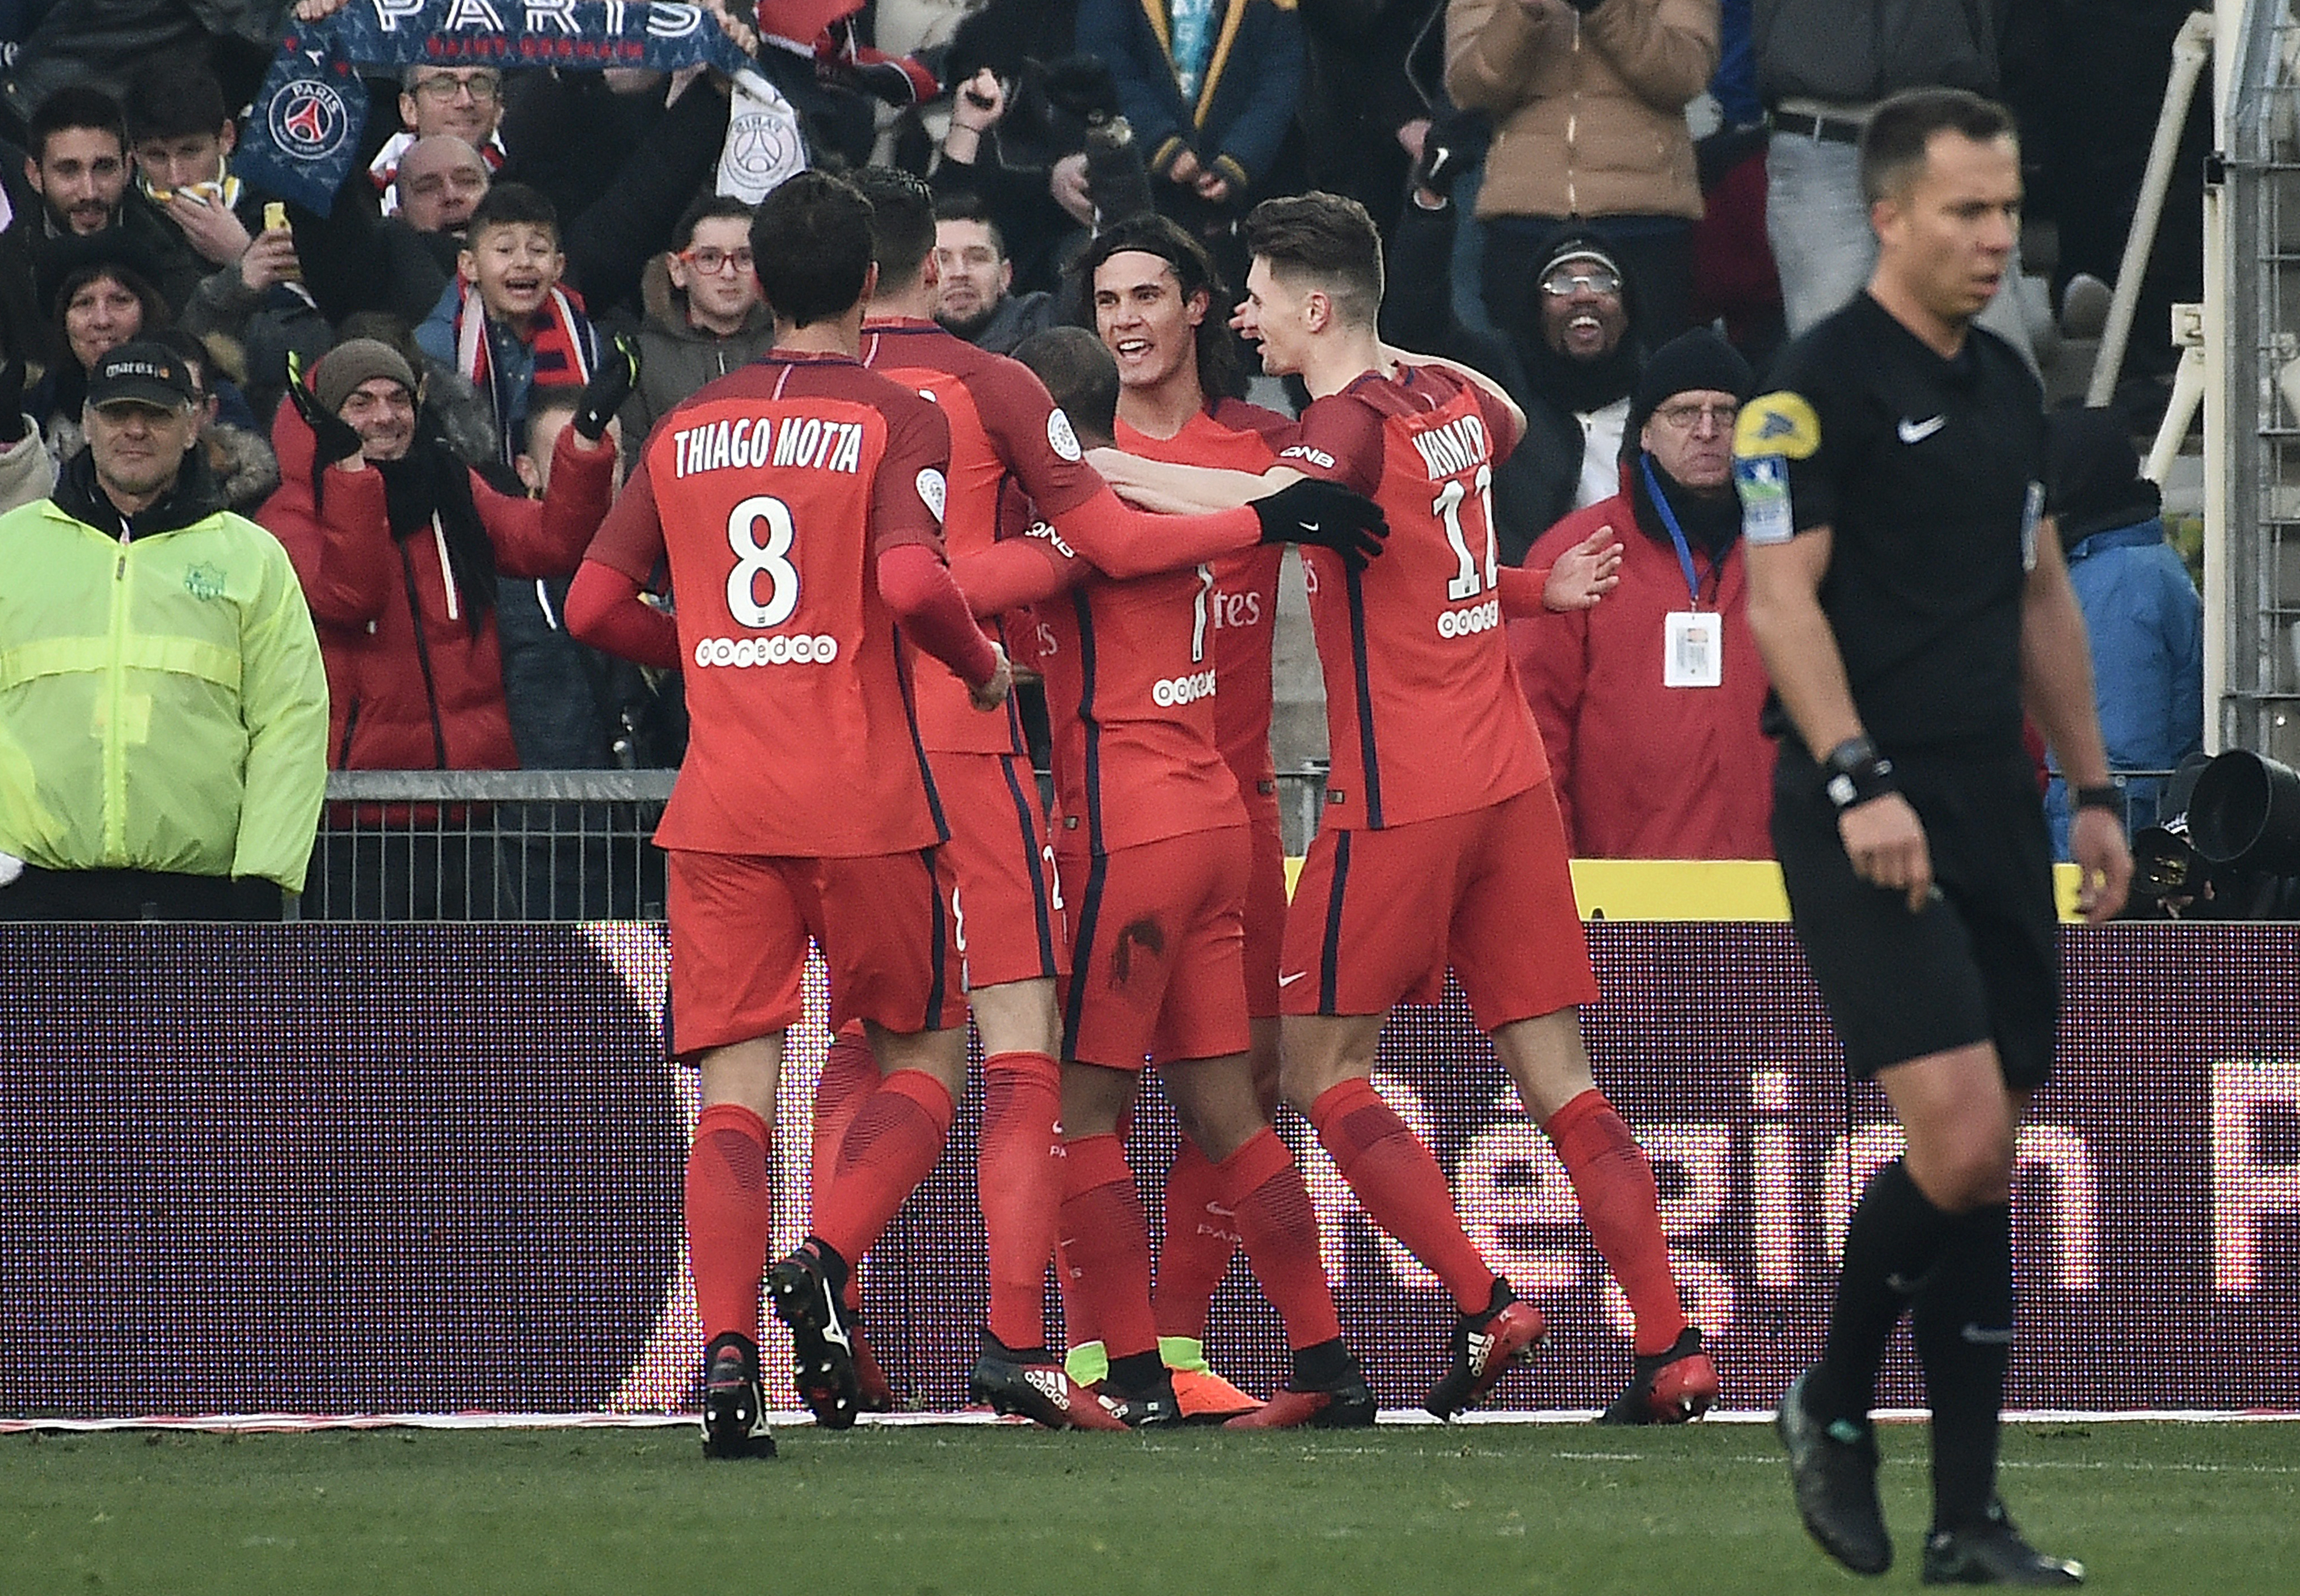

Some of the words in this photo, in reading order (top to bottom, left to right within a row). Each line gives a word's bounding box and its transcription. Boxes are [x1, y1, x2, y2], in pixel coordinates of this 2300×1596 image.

[372, 0, 702, 37] PARIS
[292, 83, 340, 114] PARIS
[674, 417, 771, 478] THIAGO
[773, 417, 863, 474] MOTTA
[1280, 446, 1335, 468] QNB
[727, 495, 799, 628] 8
[695, 634, 838, 668] ooredoo
[1299, 1062, 2099, 1339] Régin
[1024, 1371, 1070, 1411] adidas
